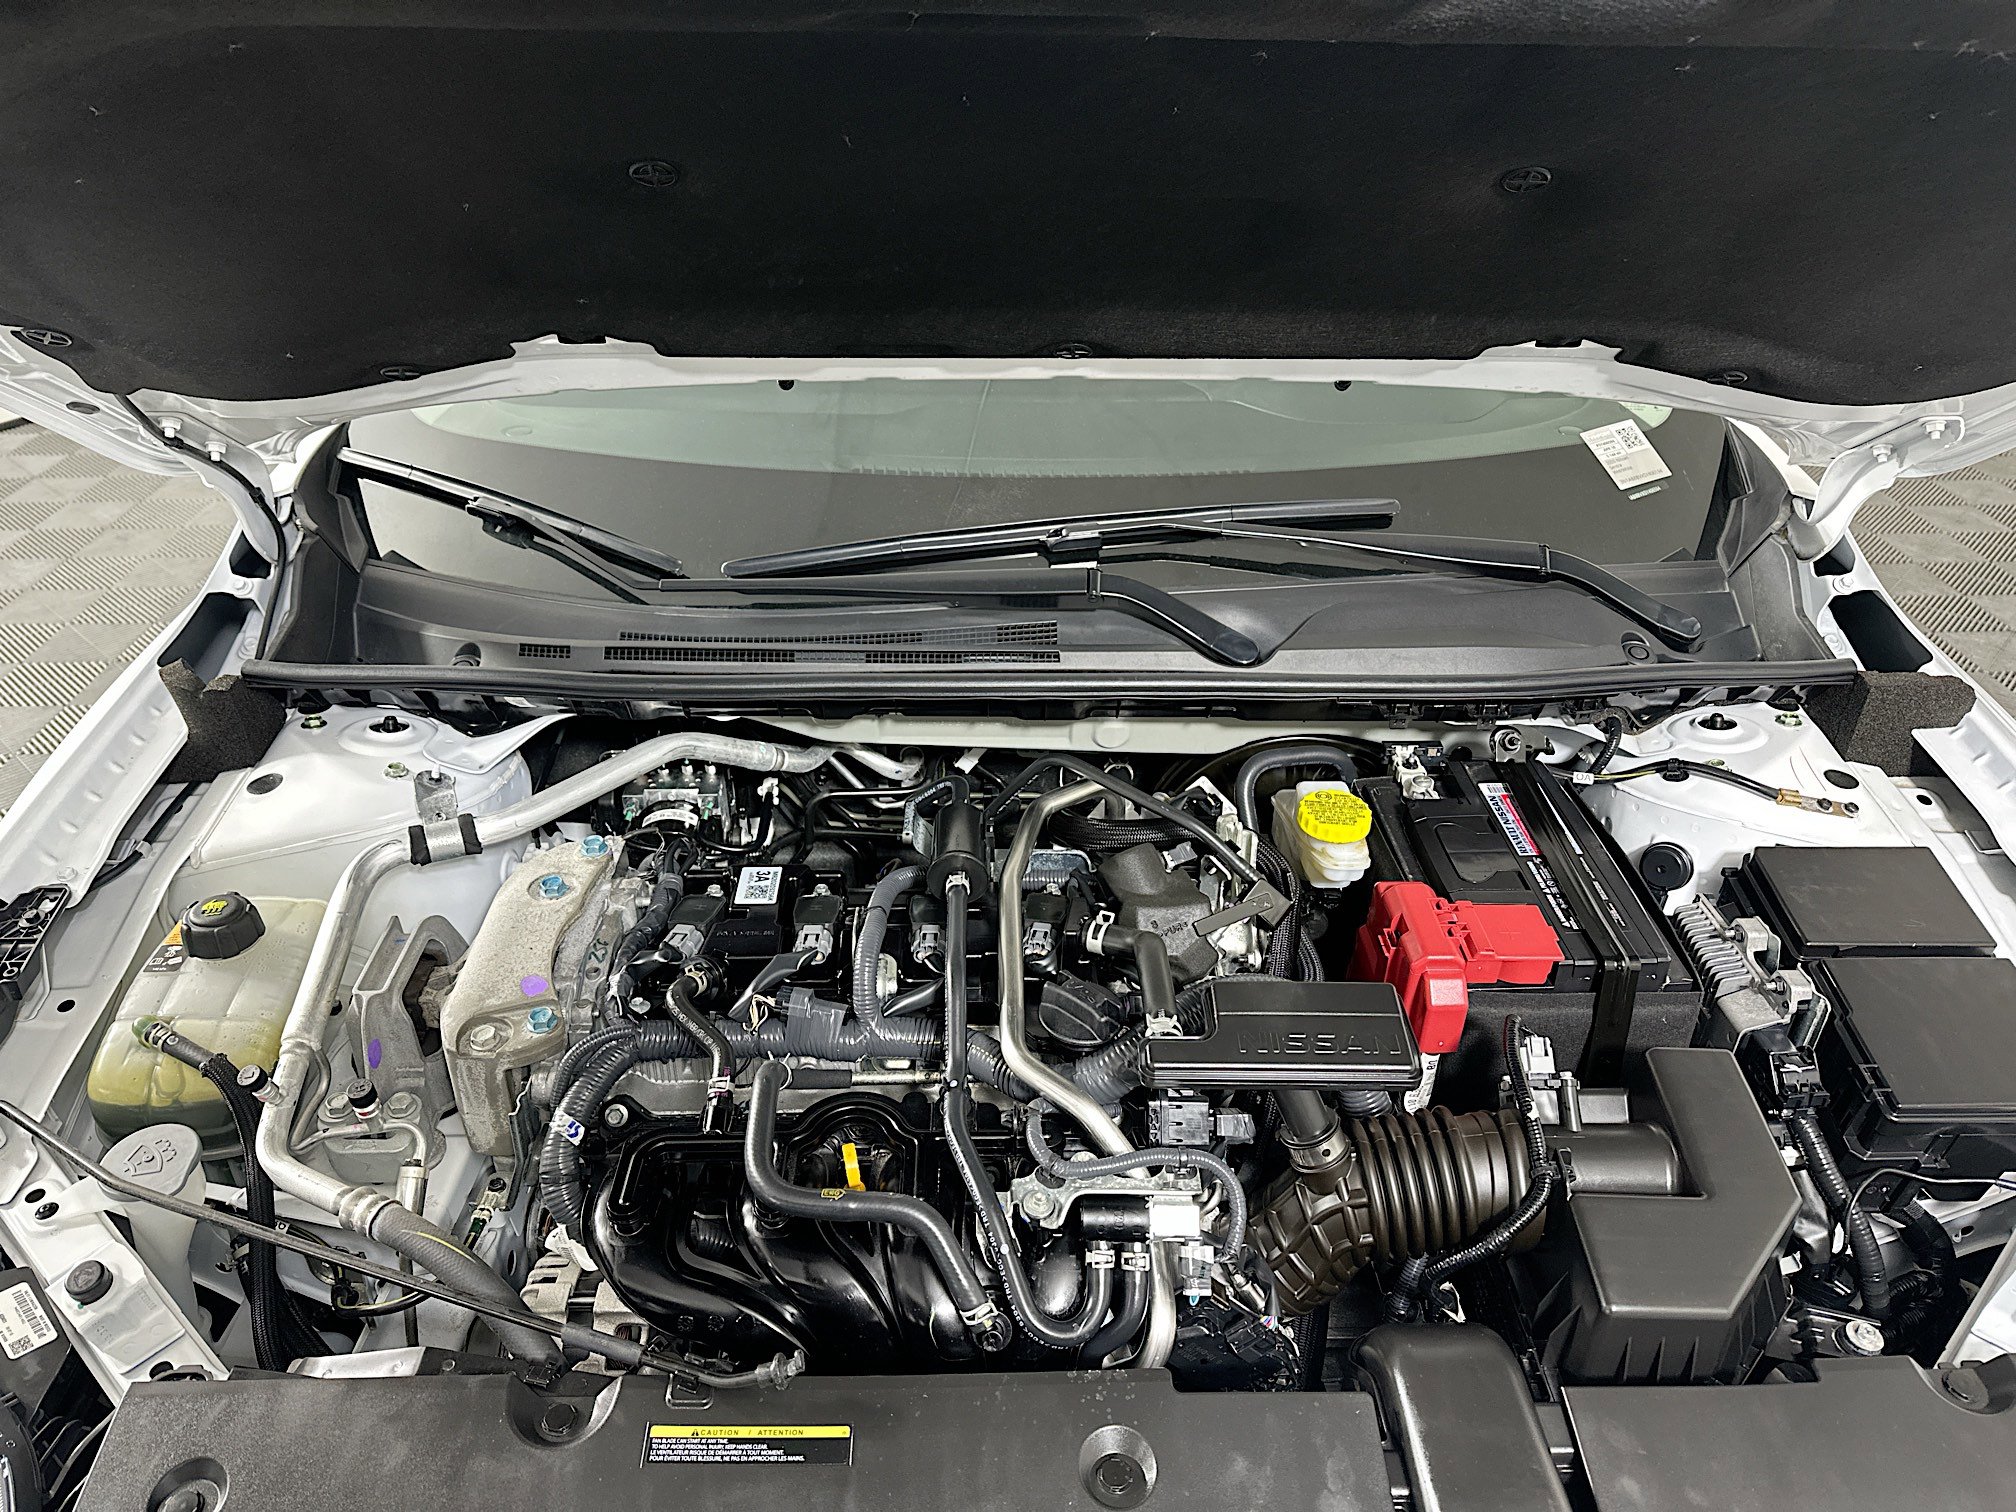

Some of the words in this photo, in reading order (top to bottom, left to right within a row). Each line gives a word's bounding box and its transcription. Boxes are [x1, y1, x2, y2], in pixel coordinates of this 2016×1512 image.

[1487, 795, 1512, 826] NISSAN
[755, 870, 771, 883] 3A
[1237, 1032, 1401, 1055] NISSAN
